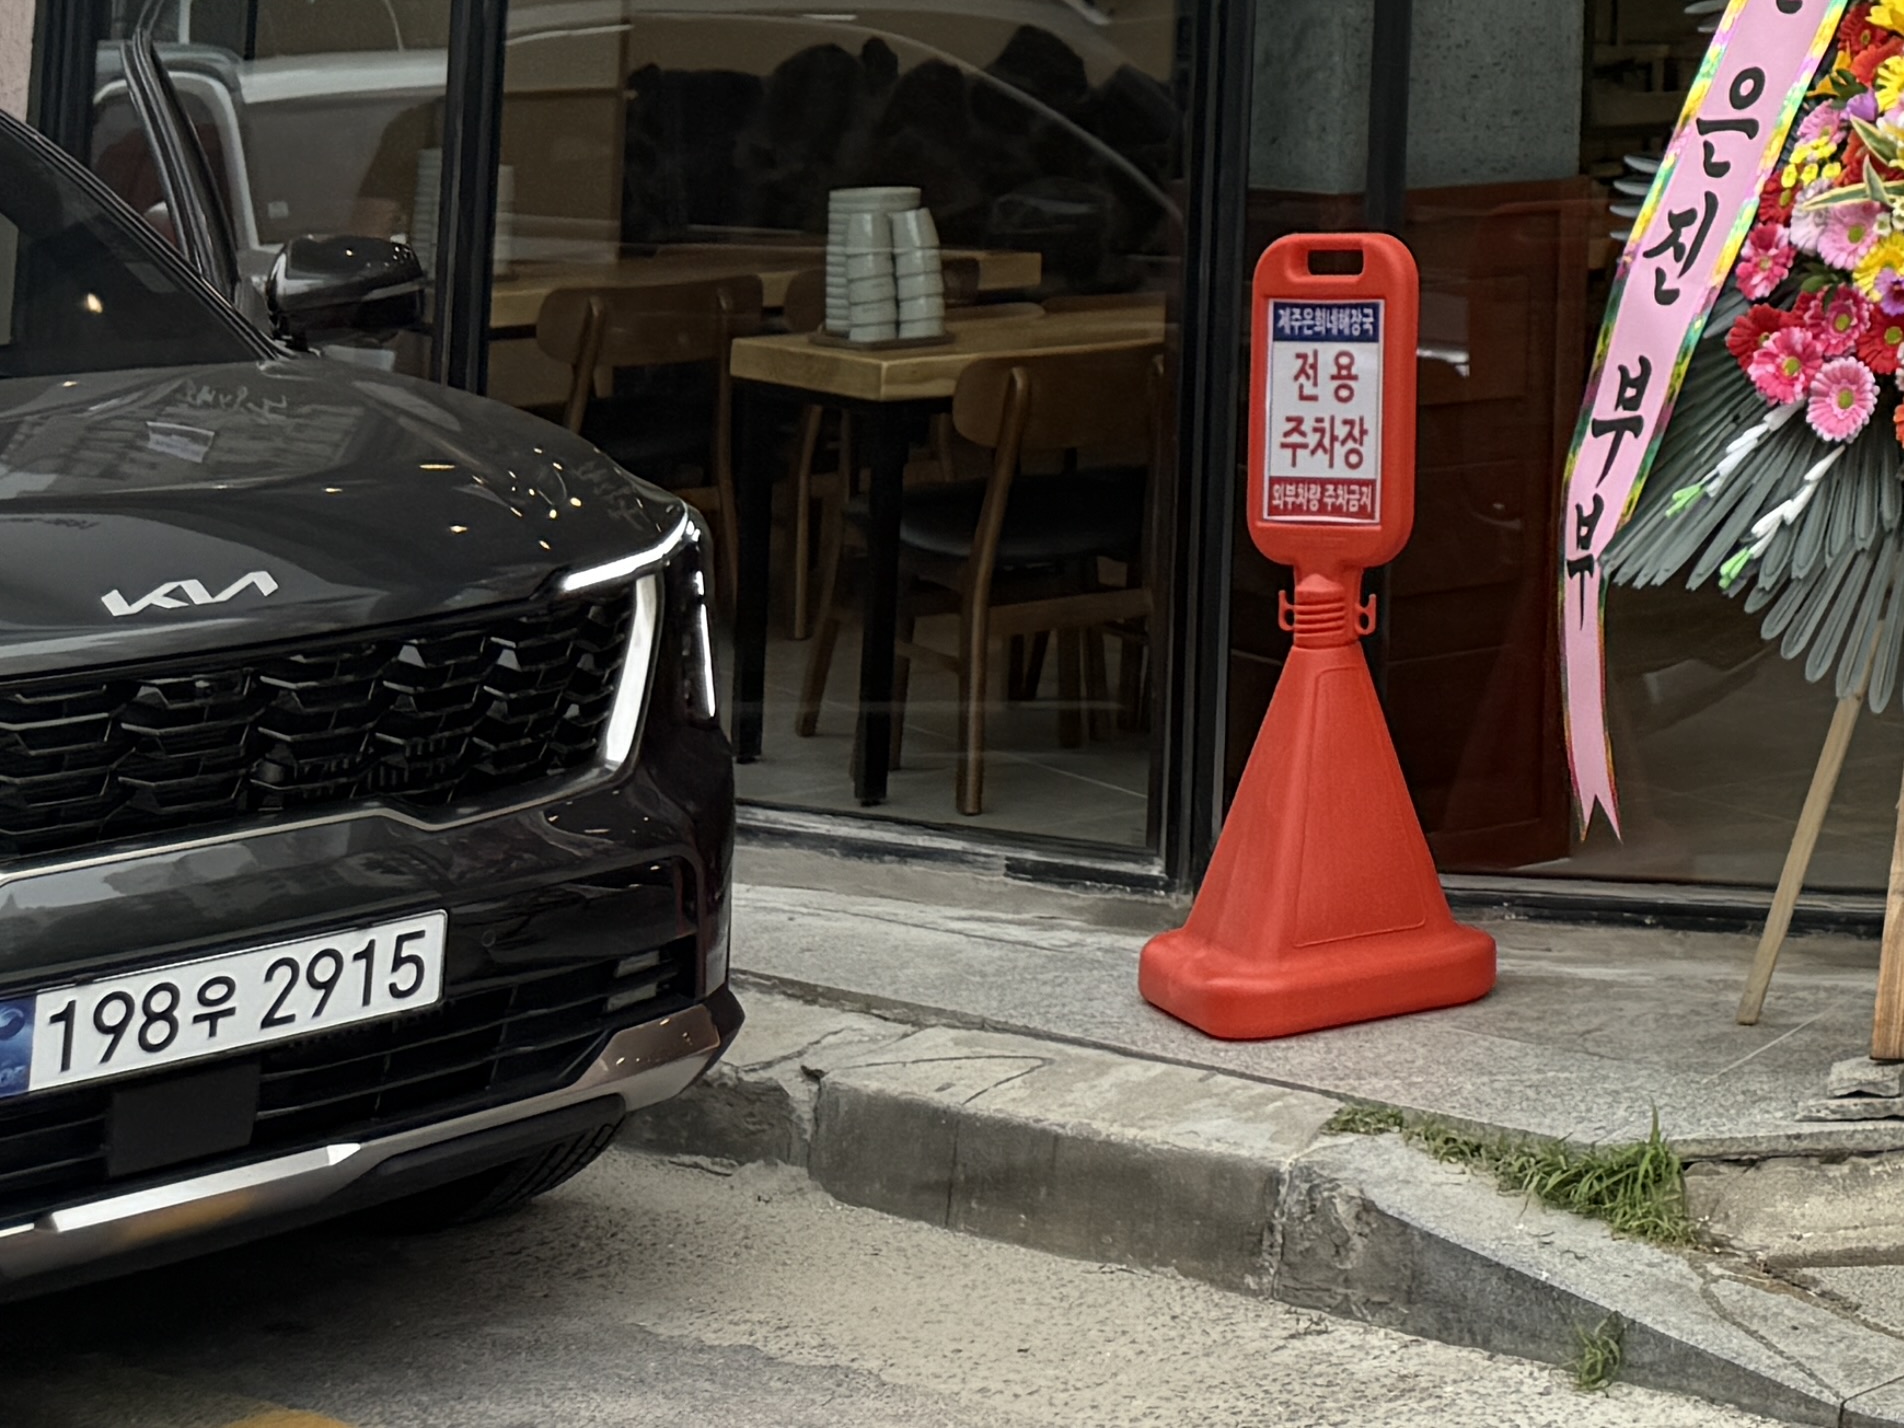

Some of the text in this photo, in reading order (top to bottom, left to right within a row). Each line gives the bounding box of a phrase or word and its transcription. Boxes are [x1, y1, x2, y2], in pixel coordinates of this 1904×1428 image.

[1641, 64, 1767, 307] 은진
[1271, 482, 1373, 514] 외부차량 주차금지
[1279, 413, 1369, 471] 주차장
[1566, 353, 1654, 631] 부부
[46, 930, 428, 1073] 198우 2915
